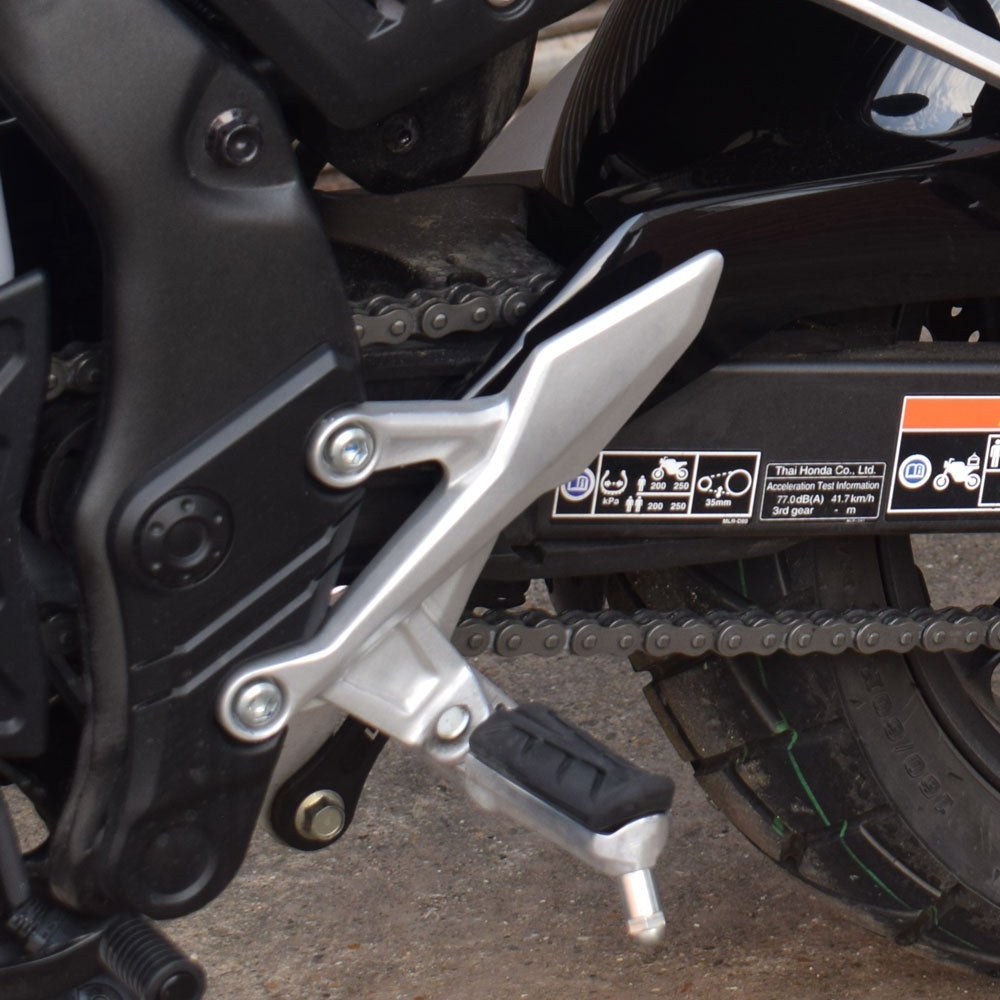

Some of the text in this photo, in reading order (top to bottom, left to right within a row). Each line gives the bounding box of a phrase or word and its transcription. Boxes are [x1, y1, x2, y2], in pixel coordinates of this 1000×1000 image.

[775, 465, 877, 476] Thai Honda Co., Ltd.
[650, 482, 690, 490] 200 250
[767, 481, 880, 491] Acceleration Test Information
[602, 497, 620, 505] kPa
[705, 499, 732, 507] 35mm
[647, 502, 687, 511] 200 250
[772, 507, 789, 516] 3rd
[791, 507, 815, 517] gear
